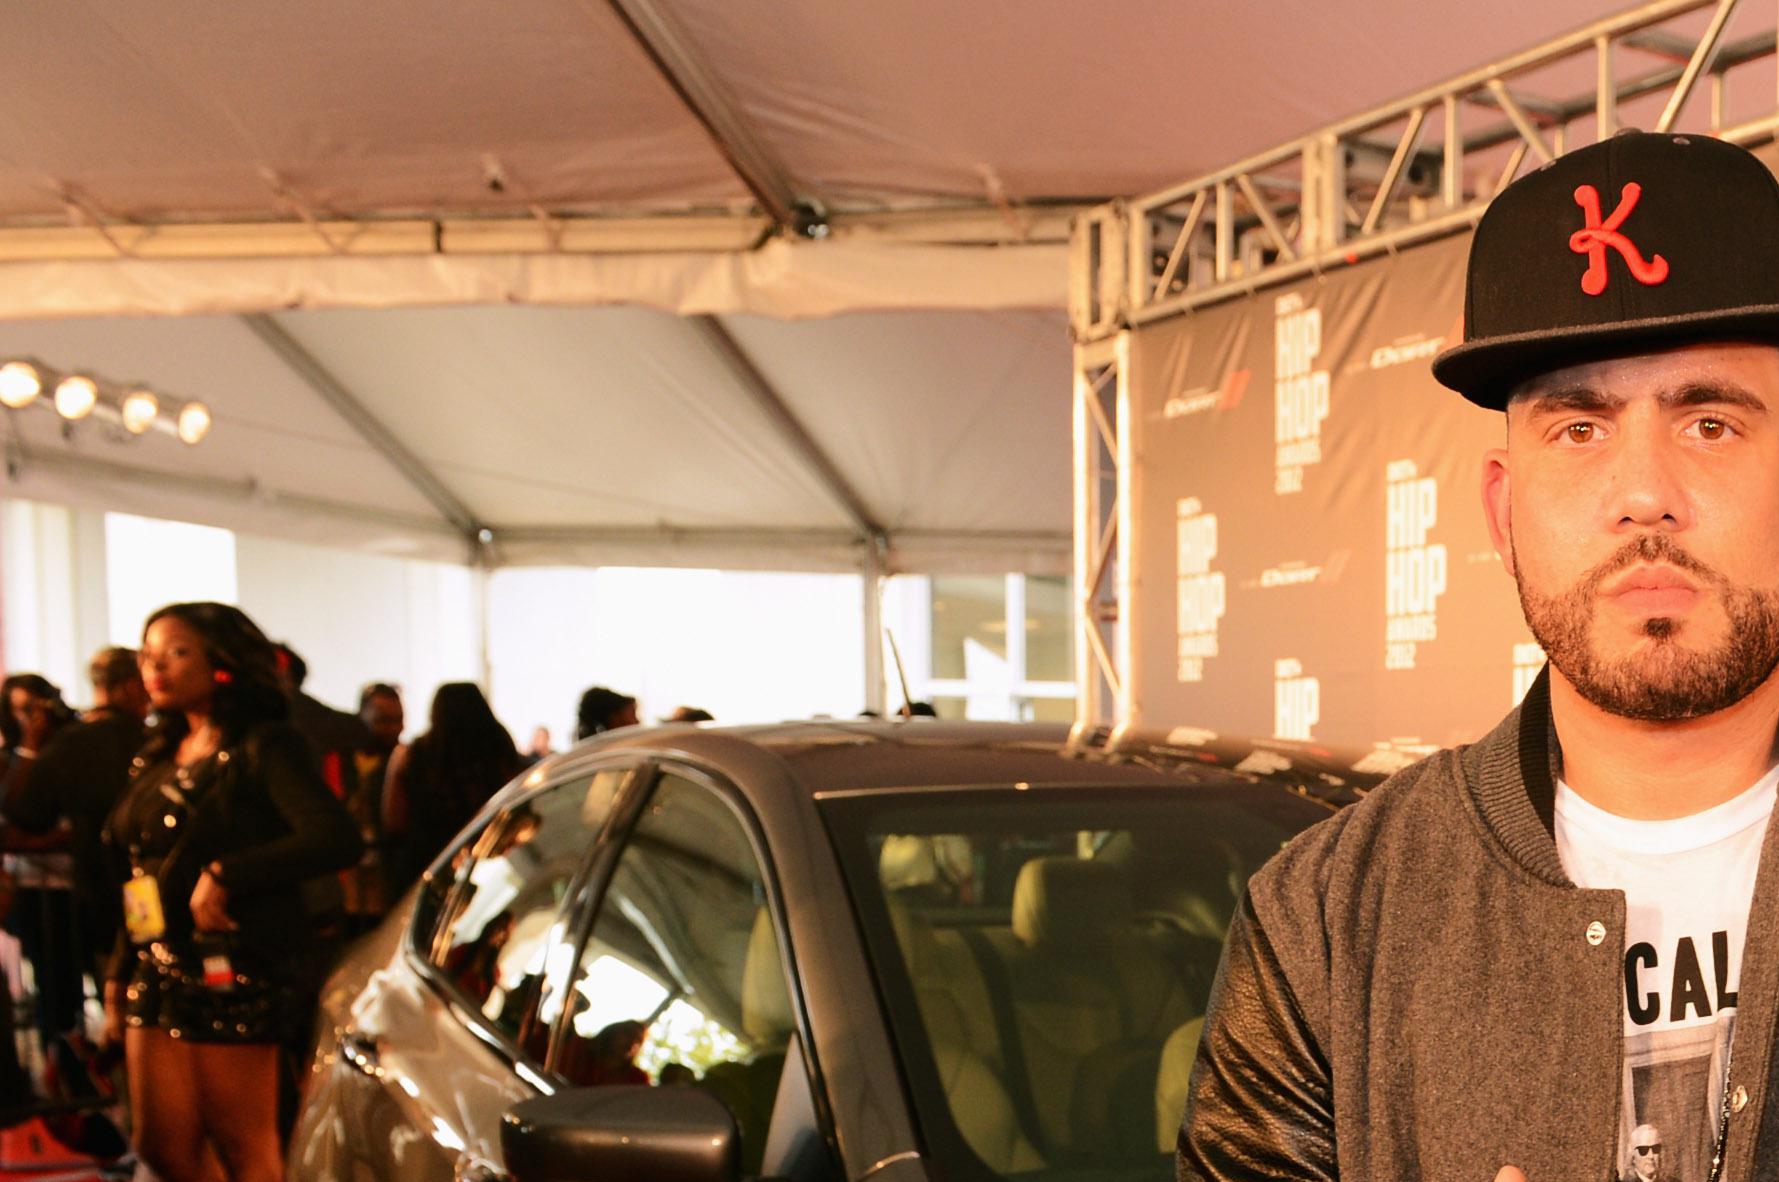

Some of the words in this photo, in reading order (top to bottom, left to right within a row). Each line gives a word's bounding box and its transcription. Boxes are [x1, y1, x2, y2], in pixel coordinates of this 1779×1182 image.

[1569, 182, 1670, 295] K
[1386, 477, 1437, 549] HIP
[1386, 544, 1447, 616] HOP
[1624, 930, 1738, 1026] CAL
